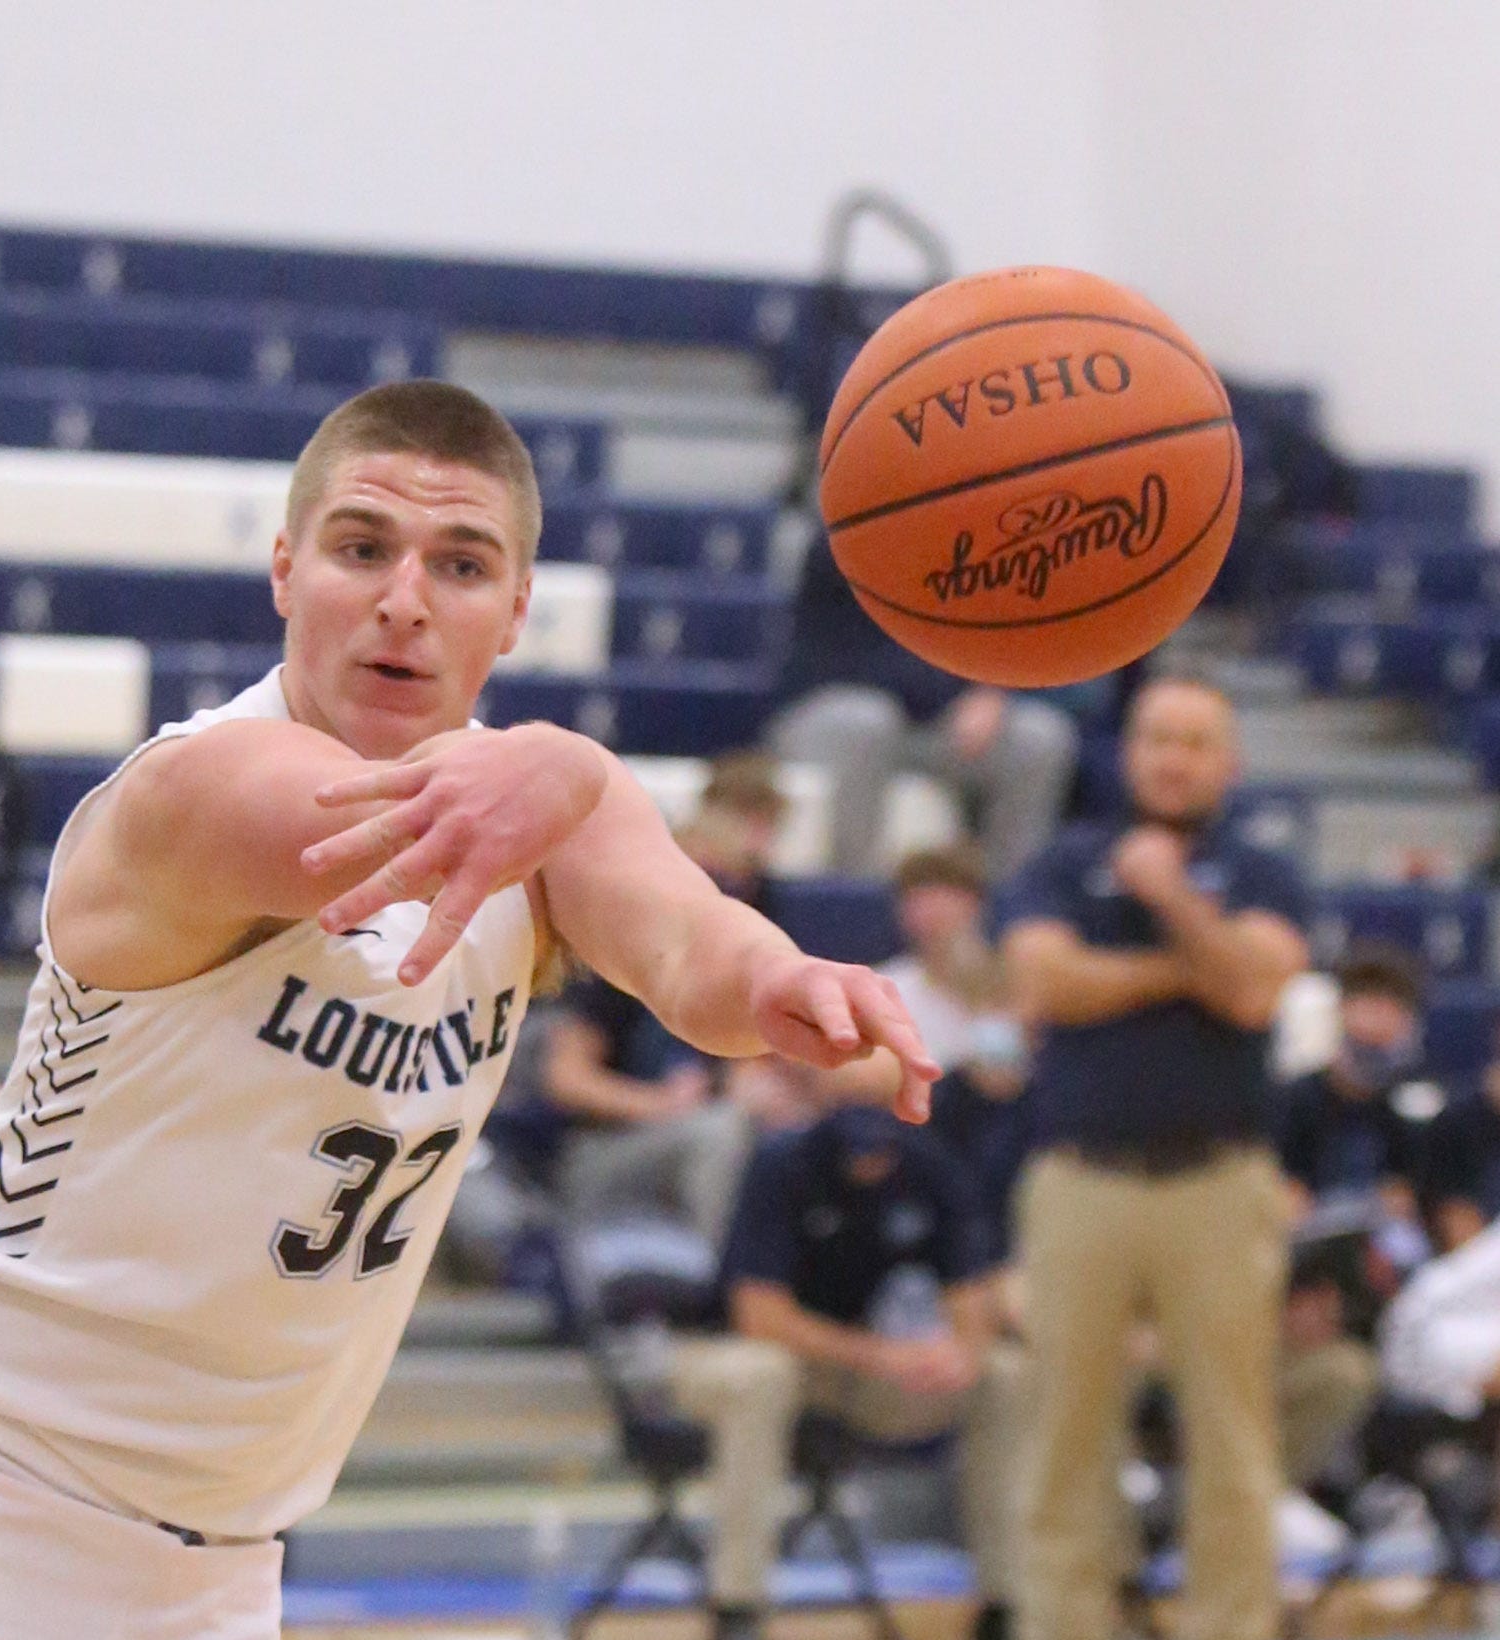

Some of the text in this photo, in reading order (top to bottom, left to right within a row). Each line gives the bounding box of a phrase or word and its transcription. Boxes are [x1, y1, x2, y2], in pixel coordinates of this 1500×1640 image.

[891, 349, 1132, 448] OHSAA
[926, 473, 1168, 601] Rawlings
[269, 1119, 464, 1281] 32
